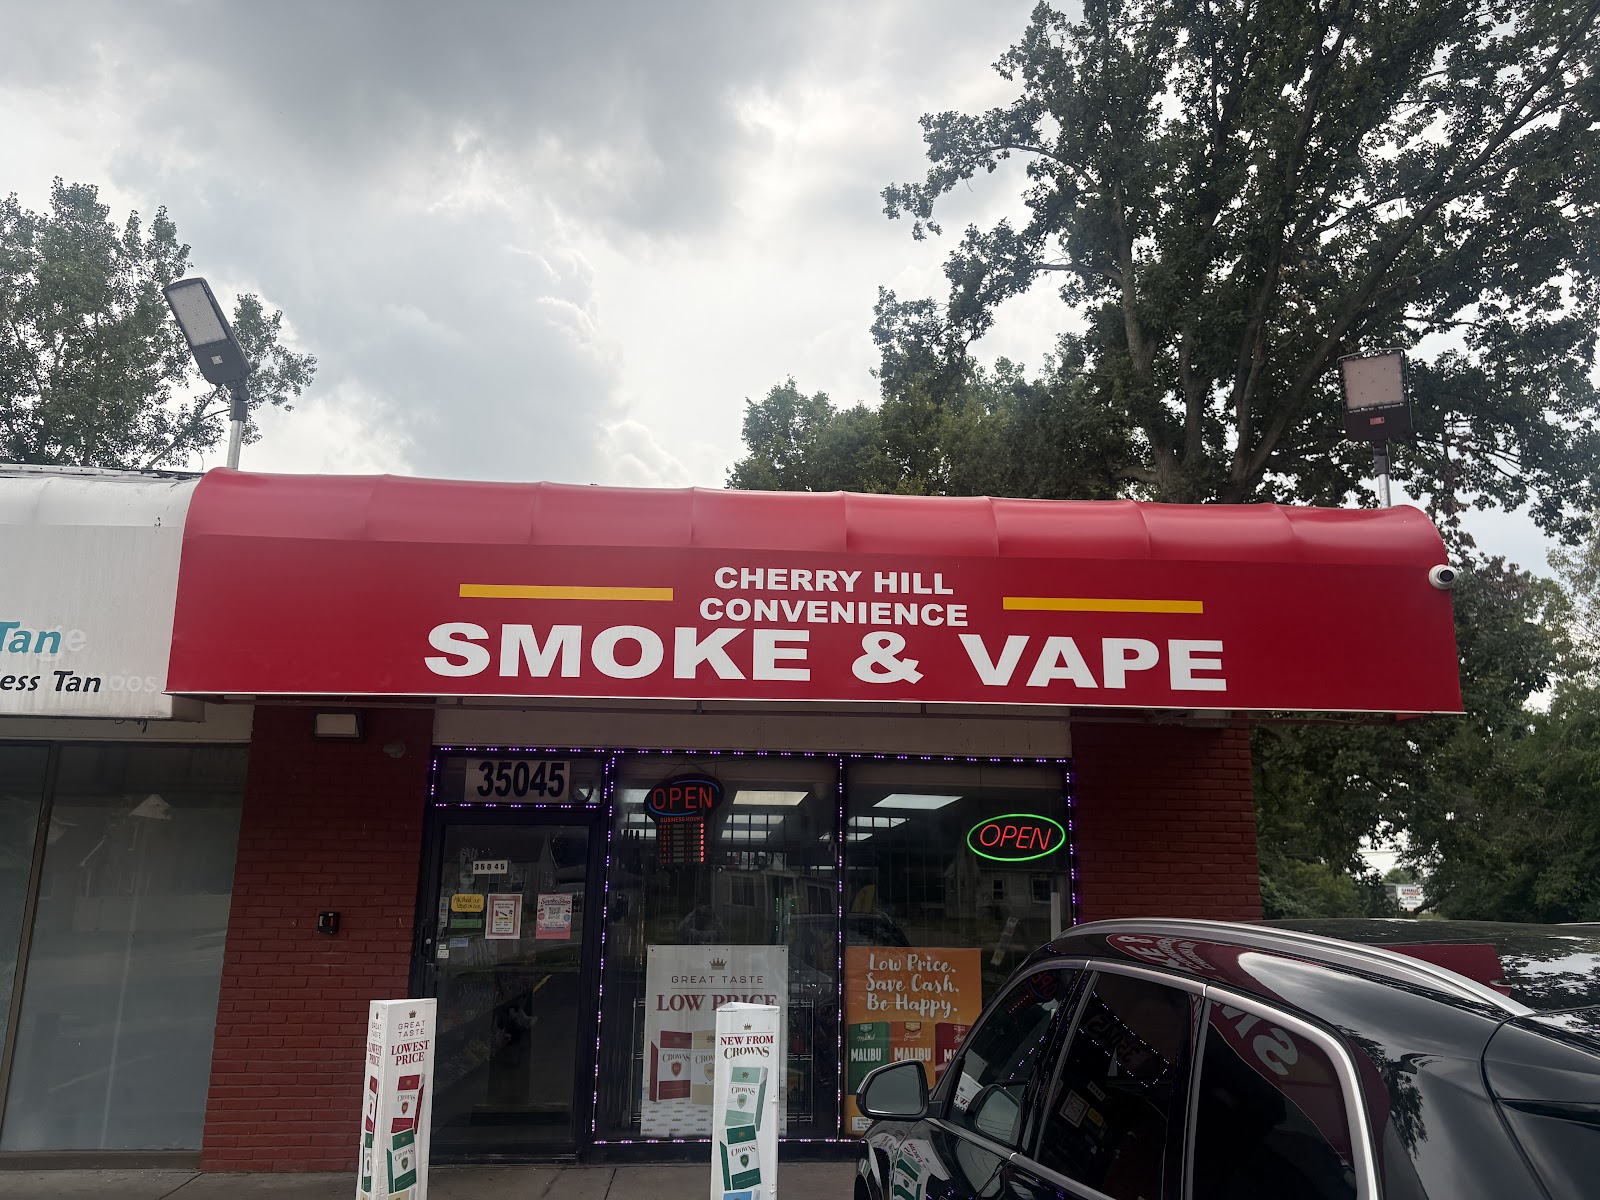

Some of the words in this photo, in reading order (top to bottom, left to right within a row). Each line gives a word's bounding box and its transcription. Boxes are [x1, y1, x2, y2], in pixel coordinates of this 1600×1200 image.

[714, 566, 862, 592] CHERRY
[874, 571, 954, 595] HILL
[699, 597, 968, 627] CONVENIENCE
[0, 621, 62, 654] Tan
[424, 622, 811, 682] SMOKE
[851, 630, 925, 685] &
[957, 633, 1227, 691] VAPE
[0, 674, 41, 691] ess
[53, 670, 102, 693] Tan
[477, 761, 565, 798] 35045
[652, 786, 713, 810] OPEN
[980, 824, 1052, 850] OPEN
[869, 952, 902, 972] Low
[907, 953, 956, 973] Price.
[672, 976, 715, 984] GREAT
[722, 976, 764, 984] TASTE
[866, 972, 906, 992] Save
[911, 974, 960, 994] Cash.
[656, 994, 706, 1011] LOW
[866, 993, 890, 1011] Be
[895, 994, 958, 1019] Happy.
[398, 1020, 426, 1030] GREAT
[398, 1028, 424, 1038] TASTE
[720, 1036, 744, 1045] NEW
[746, 1035, 774, 1044] FROM
[390, 1040, 430, 1056] LOWEST
[724, 1046, 770, 1059] CROWNS
[851, 1047, 882, 1062] MALIBU
[894, 1047, 932, 1062] MALIBU
[395, 1052, 425, 1066] PRICE
[662, 1053, 690, 1062] CROWNS
[695, 1054, 715, 1064] CROW
[731, 1086, 756, 1095] CROWNS
[394, 1148, 414, 1162] CROWNS
[731, 1145, 756, 1157] CROWNS
